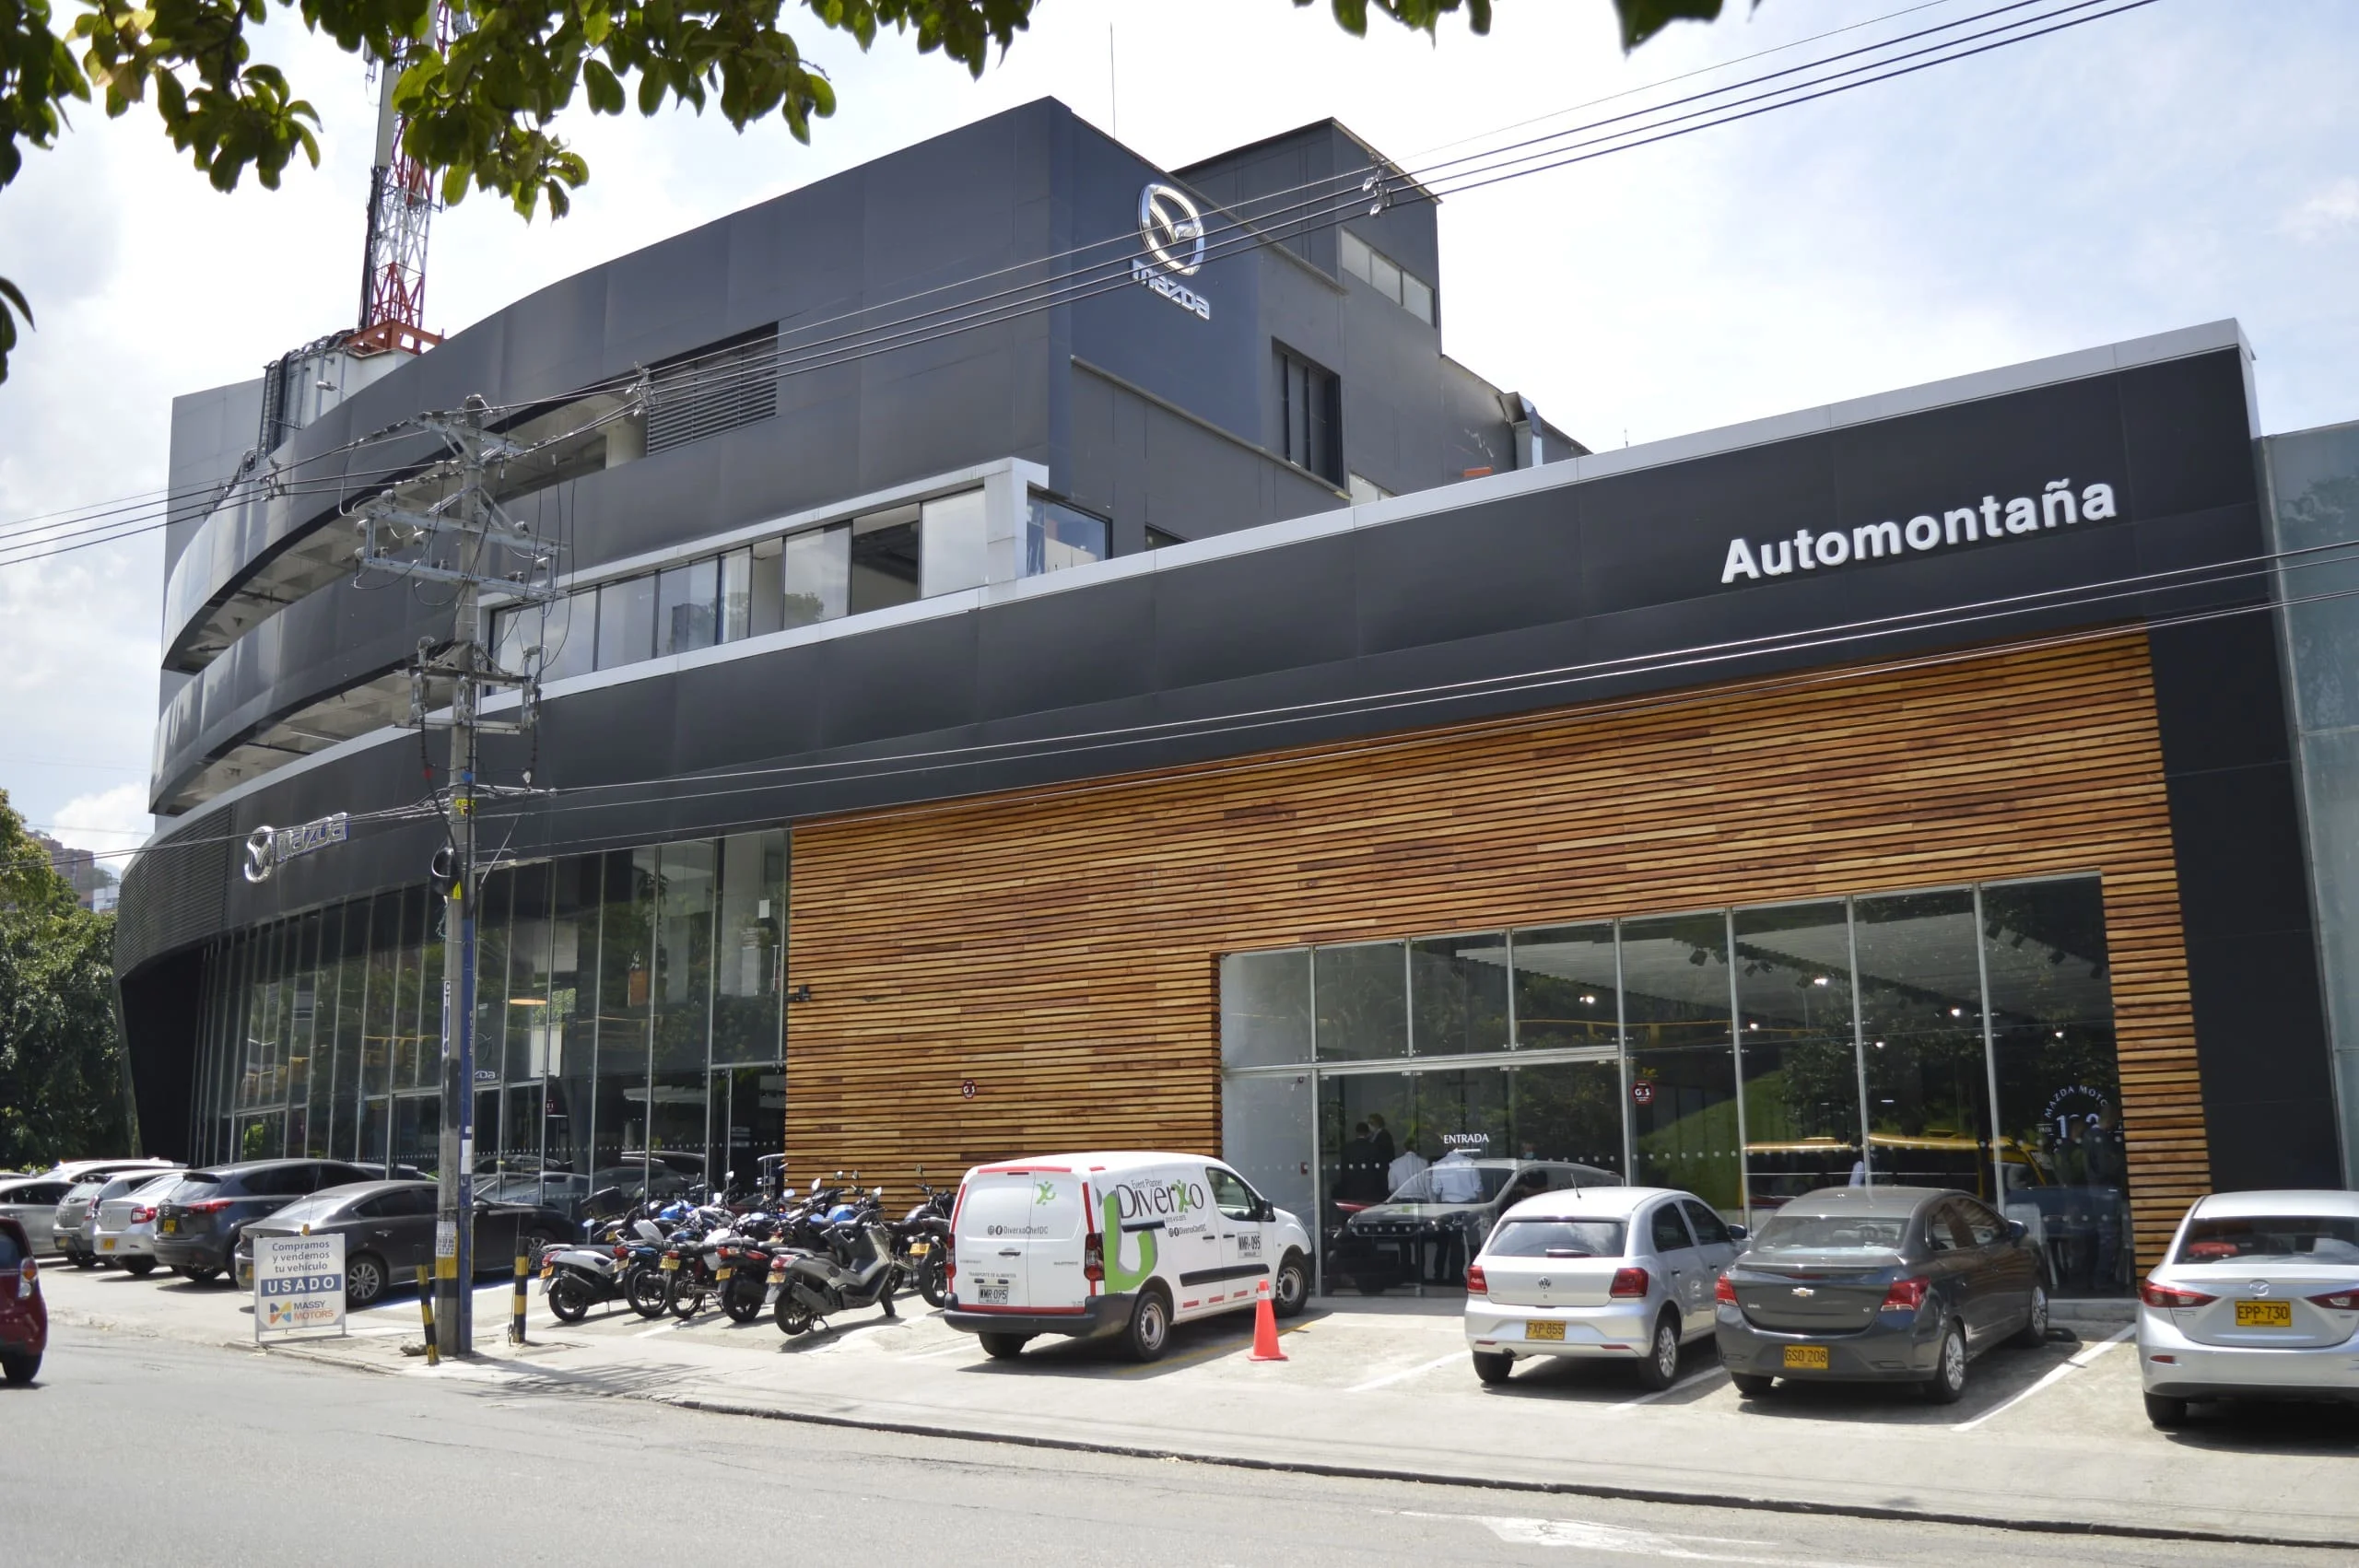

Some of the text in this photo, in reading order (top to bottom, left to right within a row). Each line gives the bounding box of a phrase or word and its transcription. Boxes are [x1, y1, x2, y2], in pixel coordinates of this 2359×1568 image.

[1721, 477, 2118, 584] Automontaña
[2044, 1084, 2108, 1118] MAZDA MOTO
[1443, 1133, 1490, 1144] ENTRADA
[272, 1241, 330, 1251] Compramos
[281, 1252, 330, 1261] vendemos
[275, 1261, 328, 1273] tu vehículo
[267, 1276, 334, 1293] USADO
[294, 1300, 326, 1310] MASSY
[294, 1309, 334, 1320] MOTORS
